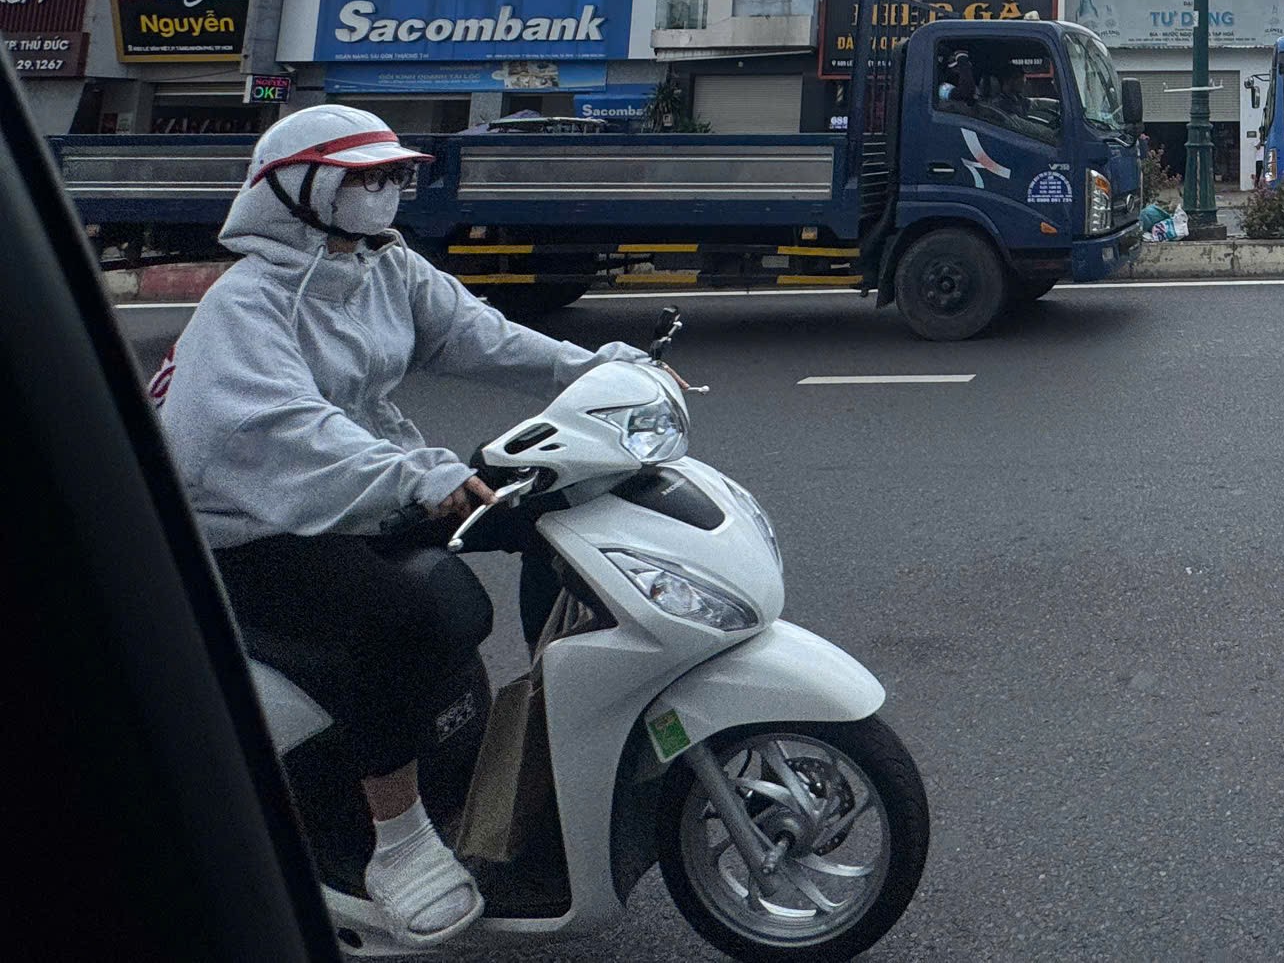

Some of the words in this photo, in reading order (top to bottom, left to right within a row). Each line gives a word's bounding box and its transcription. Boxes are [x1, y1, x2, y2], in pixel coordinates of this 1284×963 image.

[140, 10, 235, 38] Nguyễn
[335, 0, 607, 43] Sacombank
[1181, 11, 1235, 27] DNG
[20, 35, 42, 51] THỦ
[43, 35, 70, 51] ĐỨC
[837, 33, 854, 50] ĐÀ
[254, 87, 283, 99] OKE
[582, 104, 644, 117] Sacomba
